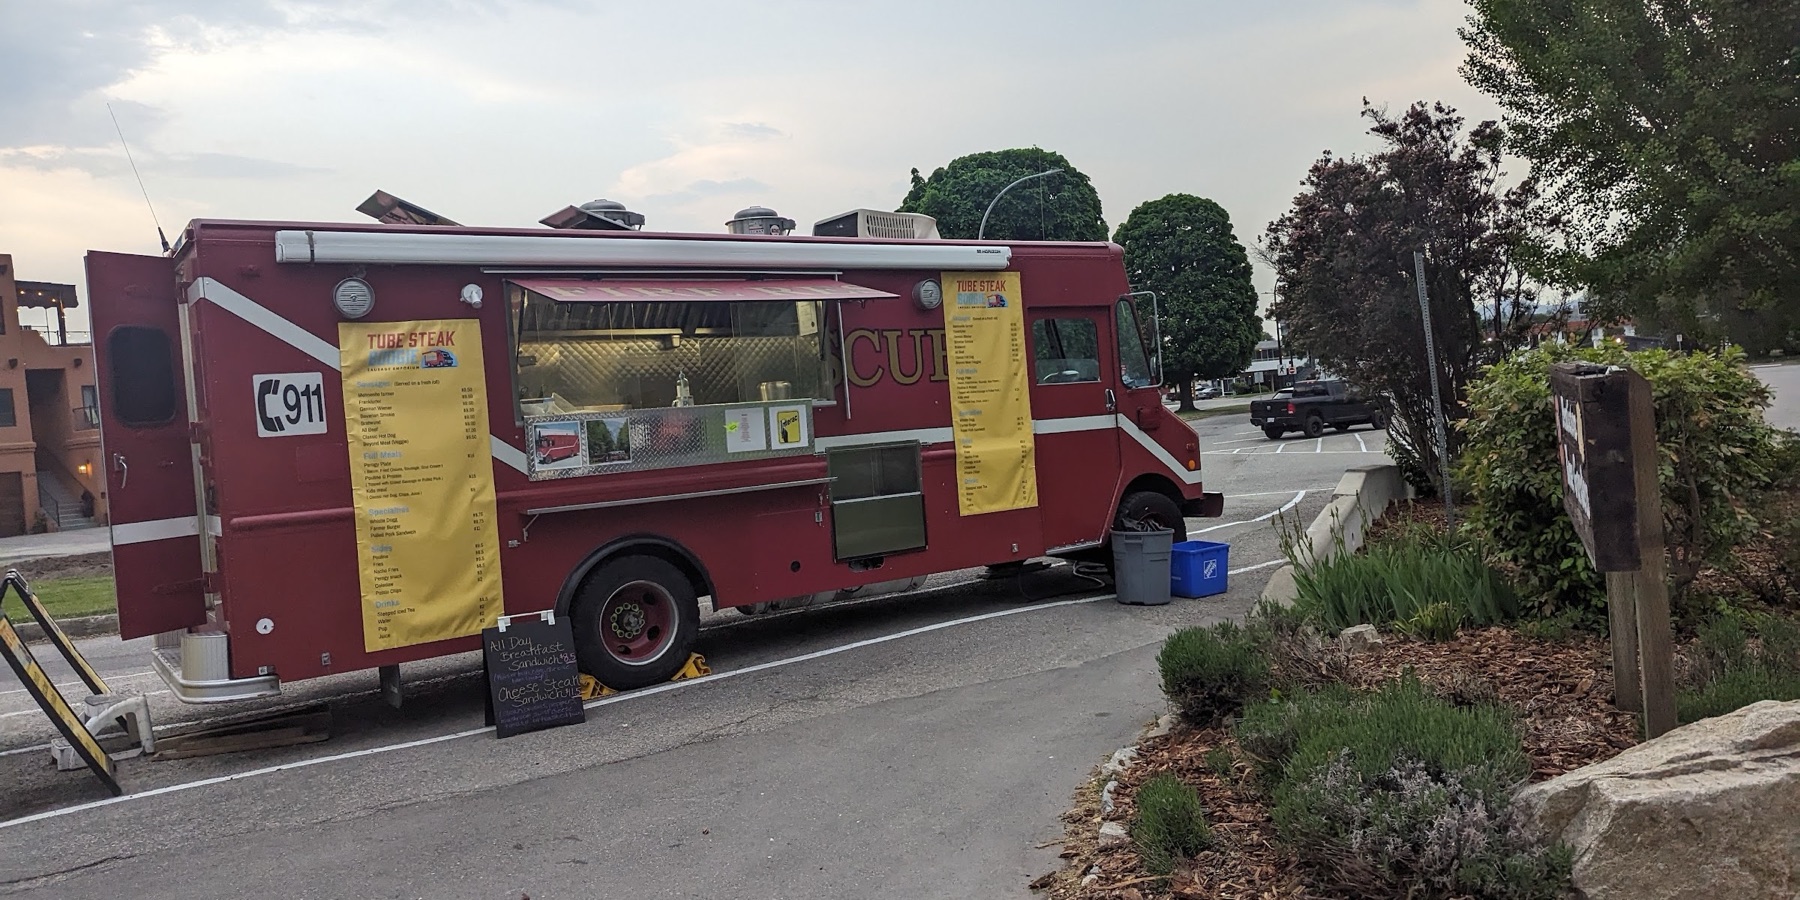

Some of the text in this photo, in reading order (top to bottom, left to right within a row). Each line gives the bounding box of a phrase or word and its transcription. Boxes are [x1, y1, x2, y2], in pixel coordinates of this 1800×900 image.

[957, 280, 1006, 292] TUBE STEAK
[367, 330, 456, 350] TUBE STEAK
[283, 384, 324, 425] 911
[490, 636, 532, 652] All Day
[500, 642, 564, 662] Breakfast
[508, 654, 563, 671] Sandwich
[498, 682, 540, 702] Cheese
[543, 674, 580, 692] Steak
[512, 688, 567, 707] Sandwich
